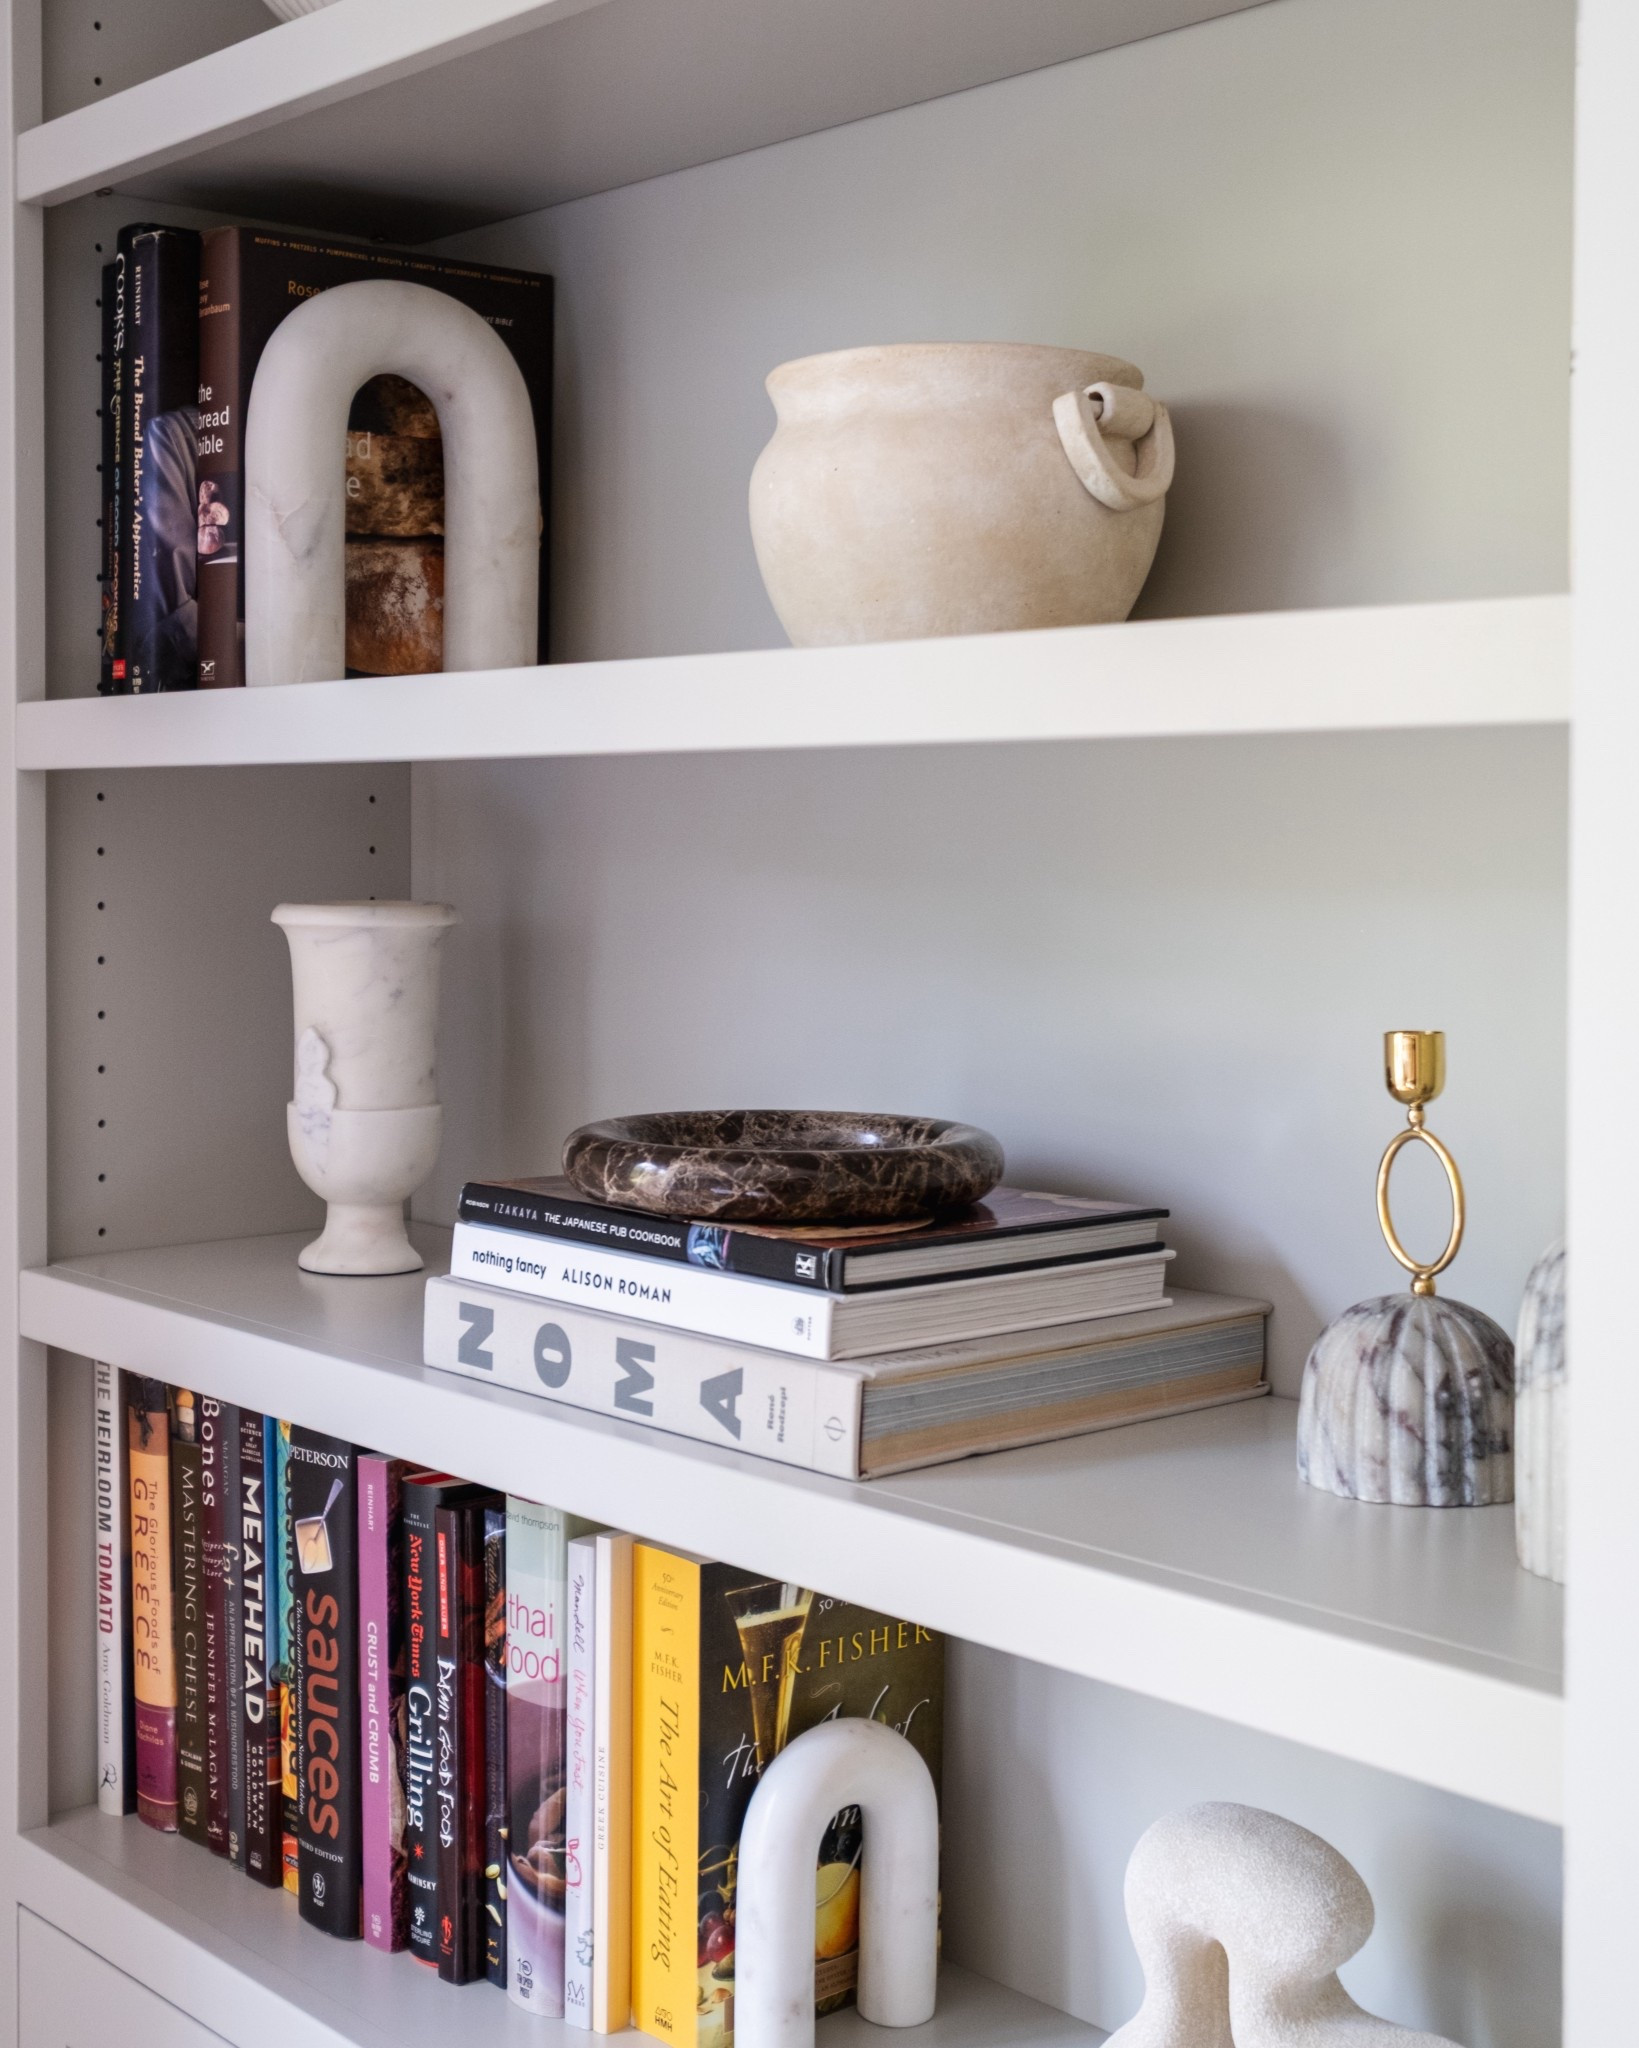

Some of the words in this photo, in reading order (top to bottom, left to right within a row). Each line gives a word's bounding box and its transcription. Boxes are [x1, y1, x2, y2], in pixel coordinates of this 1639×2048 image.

[254, 236, 281, 247] MUFFINS
[289, 242, 318, 253] PRETZELS
[326, 248, 369, 261] PUMPERNICKEL
[134, 265, 142, 326] REINHART
[134, 355, 145, 387] The
[134, 392, 144, 442] Bread
[134, 447, 144, 507] Baker's
[132, 511, 144, 600] Apprentice
[493, 1202, 538, 1220] IZAKAYA
[544, 1212, 561, 1225] THE
[562, 1215, 608, 1234] JAPANESE
[609, 1225, 628, 1239] PUB
[628, 1228, 682, 1248] COOKBOOK
[472, 1250, 513, 1273] nothing
[515, 1256, 547, 1280] fancy
[561, 1268, 613, 1290] ALISON
[618, 1279, 672, 1304] ROMAN
[96, 1361, 111, 1400] THE
[457, 1301, 744, 1442] NOMA
[97, 1409, 112, 1533] HEIRLOOM
[202, 1396, 221, 1507] Bones
[289, 1443, 349, 1470] PETERSON
[149, 1481, 158, 1511] The
[366, 1484, 374, 1532] REINHART
[521, 1513, 560, 1532] thompson
[149, 1519, 159, 1592] Glorious
[182, 1465, 197, 1623] MASTERING
[409, 1532, 423, 1574] New
[98, 1543, 114, 1634] TOMATO
[228, 1600, 235, 1615] AN
[242, 1476, 264, 1725] MEATHEAD
[407, 1574, 424, 1621] York
[508, 1593, 554, 1640] thai
[150, 1599, 161, 1649] Foods
[367, 1621, 379, 1681] CRUST
[410, 1622, 425, 1679] Times
[151, 1658, 161, 1676] of
[184, 1631, 197, 1724] CHEESE
[206, 1611, 216, 1705] JENNIFER
[650, 1663, 684, 1685] FISHER
[653, 1650, 679, 1669] M.F.K.
[722, 1648, 811, 1694] M.F.K.
[819, 1621, 933, 1668] FISHER
[102, 1680, 113, 1745] Goldman
[306, 1588, 340, 1840] sauces
[367, 1683, 380, 1715] and
[660, 1695, 681, 1757] The
[207, 1712, 218, 1801] McLAGAN
[230, 1710, 240, 1791] MISUNDERSTOOD
[368, 1718, 380, 1785] CRUMB
[407, 1685, 434, 1832] Grilling
[597, 1746, 605, 1801] CUISINE
[659, 1760, 680, 1818] Art
[314, 1846, 344, 1864] EDITION
[597, 1805, 605, 1850] GREEK
[652, 1823, 679, 1871] of
[650, 1869, 679, 1973] Eating
[654, 2015, 673, 2032] HMH
